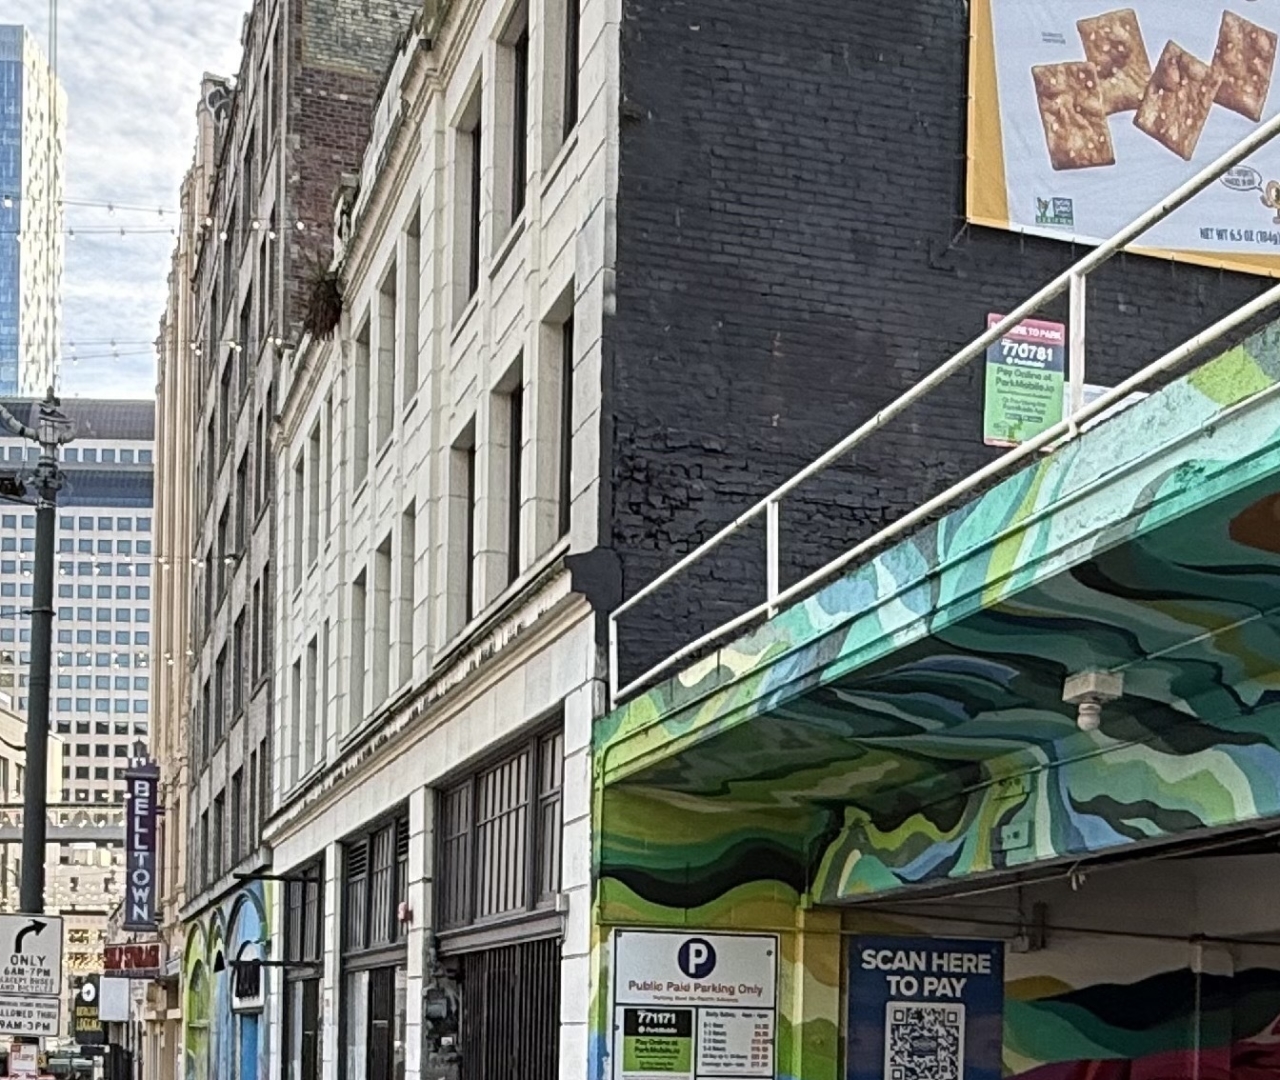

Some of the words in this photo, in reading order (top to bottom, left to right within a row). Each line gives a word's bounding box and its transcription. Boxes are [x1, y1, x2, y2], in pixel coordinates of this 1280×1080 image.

[1199, 227, 1214, 240] NET
[1215, 228, 1228, 241] WT
[1028, 327, 1040, 337] TO
[1040, 329, 1062, 340] PARK
[1001, 341, 1053, 361] 770781
[997, 366, 1013, 378] Pay
[1014, 368, 1042, 381] Online
[131, 780, 151, 922] BELLTOWN
[10, 954, 46, 967] ONLY
[861, 949, 926, 971] SCAN
[931, 951, 992, 975] HERE
[3, 966, 51, 977] 6AM-7PM
[628, 980, 663, 992] Public
[666, 981, 691, 993] Paid
[693, 982, 735, 996] Parking
[738, 983, 763, 998] Only
[886, 975, 919, 996] TO
[922, 976, 967, 998] PAY
[637, 1011, 676, 1025] 771171
